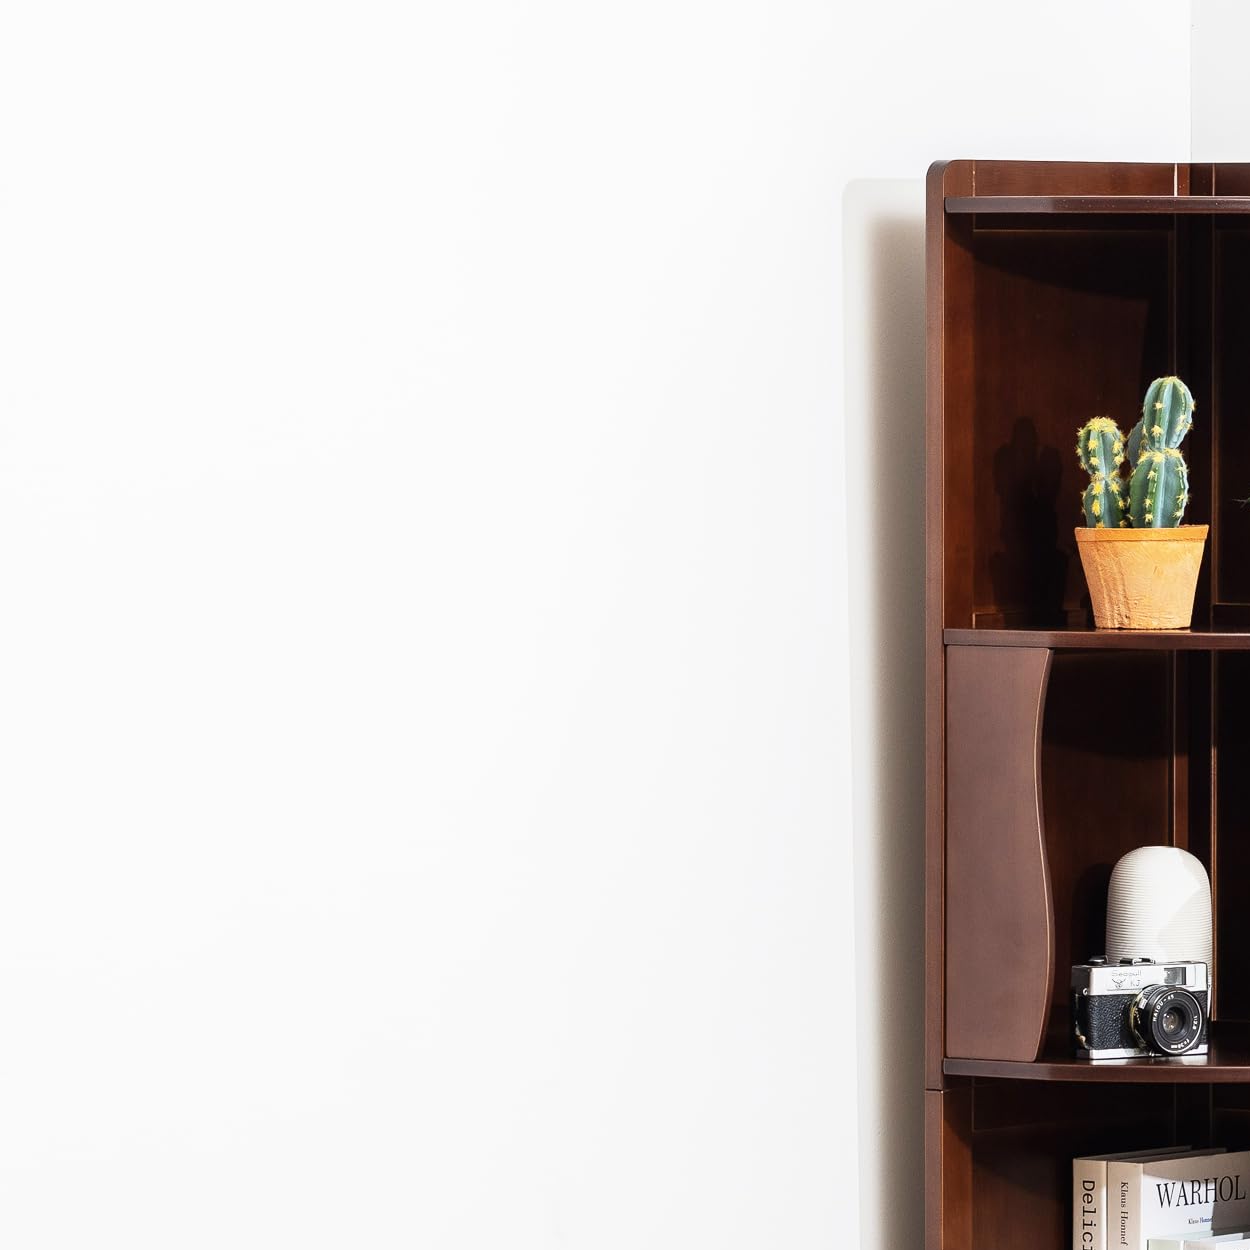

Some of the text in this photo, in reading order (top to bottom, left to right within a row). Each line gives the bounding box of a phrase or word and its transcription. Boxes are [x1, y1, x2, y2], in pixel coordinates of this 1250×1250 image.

[1120, 1181, 1129, 1246] Klaus Honnef
[1156, 1175, 1246, 1208] WARHOL
